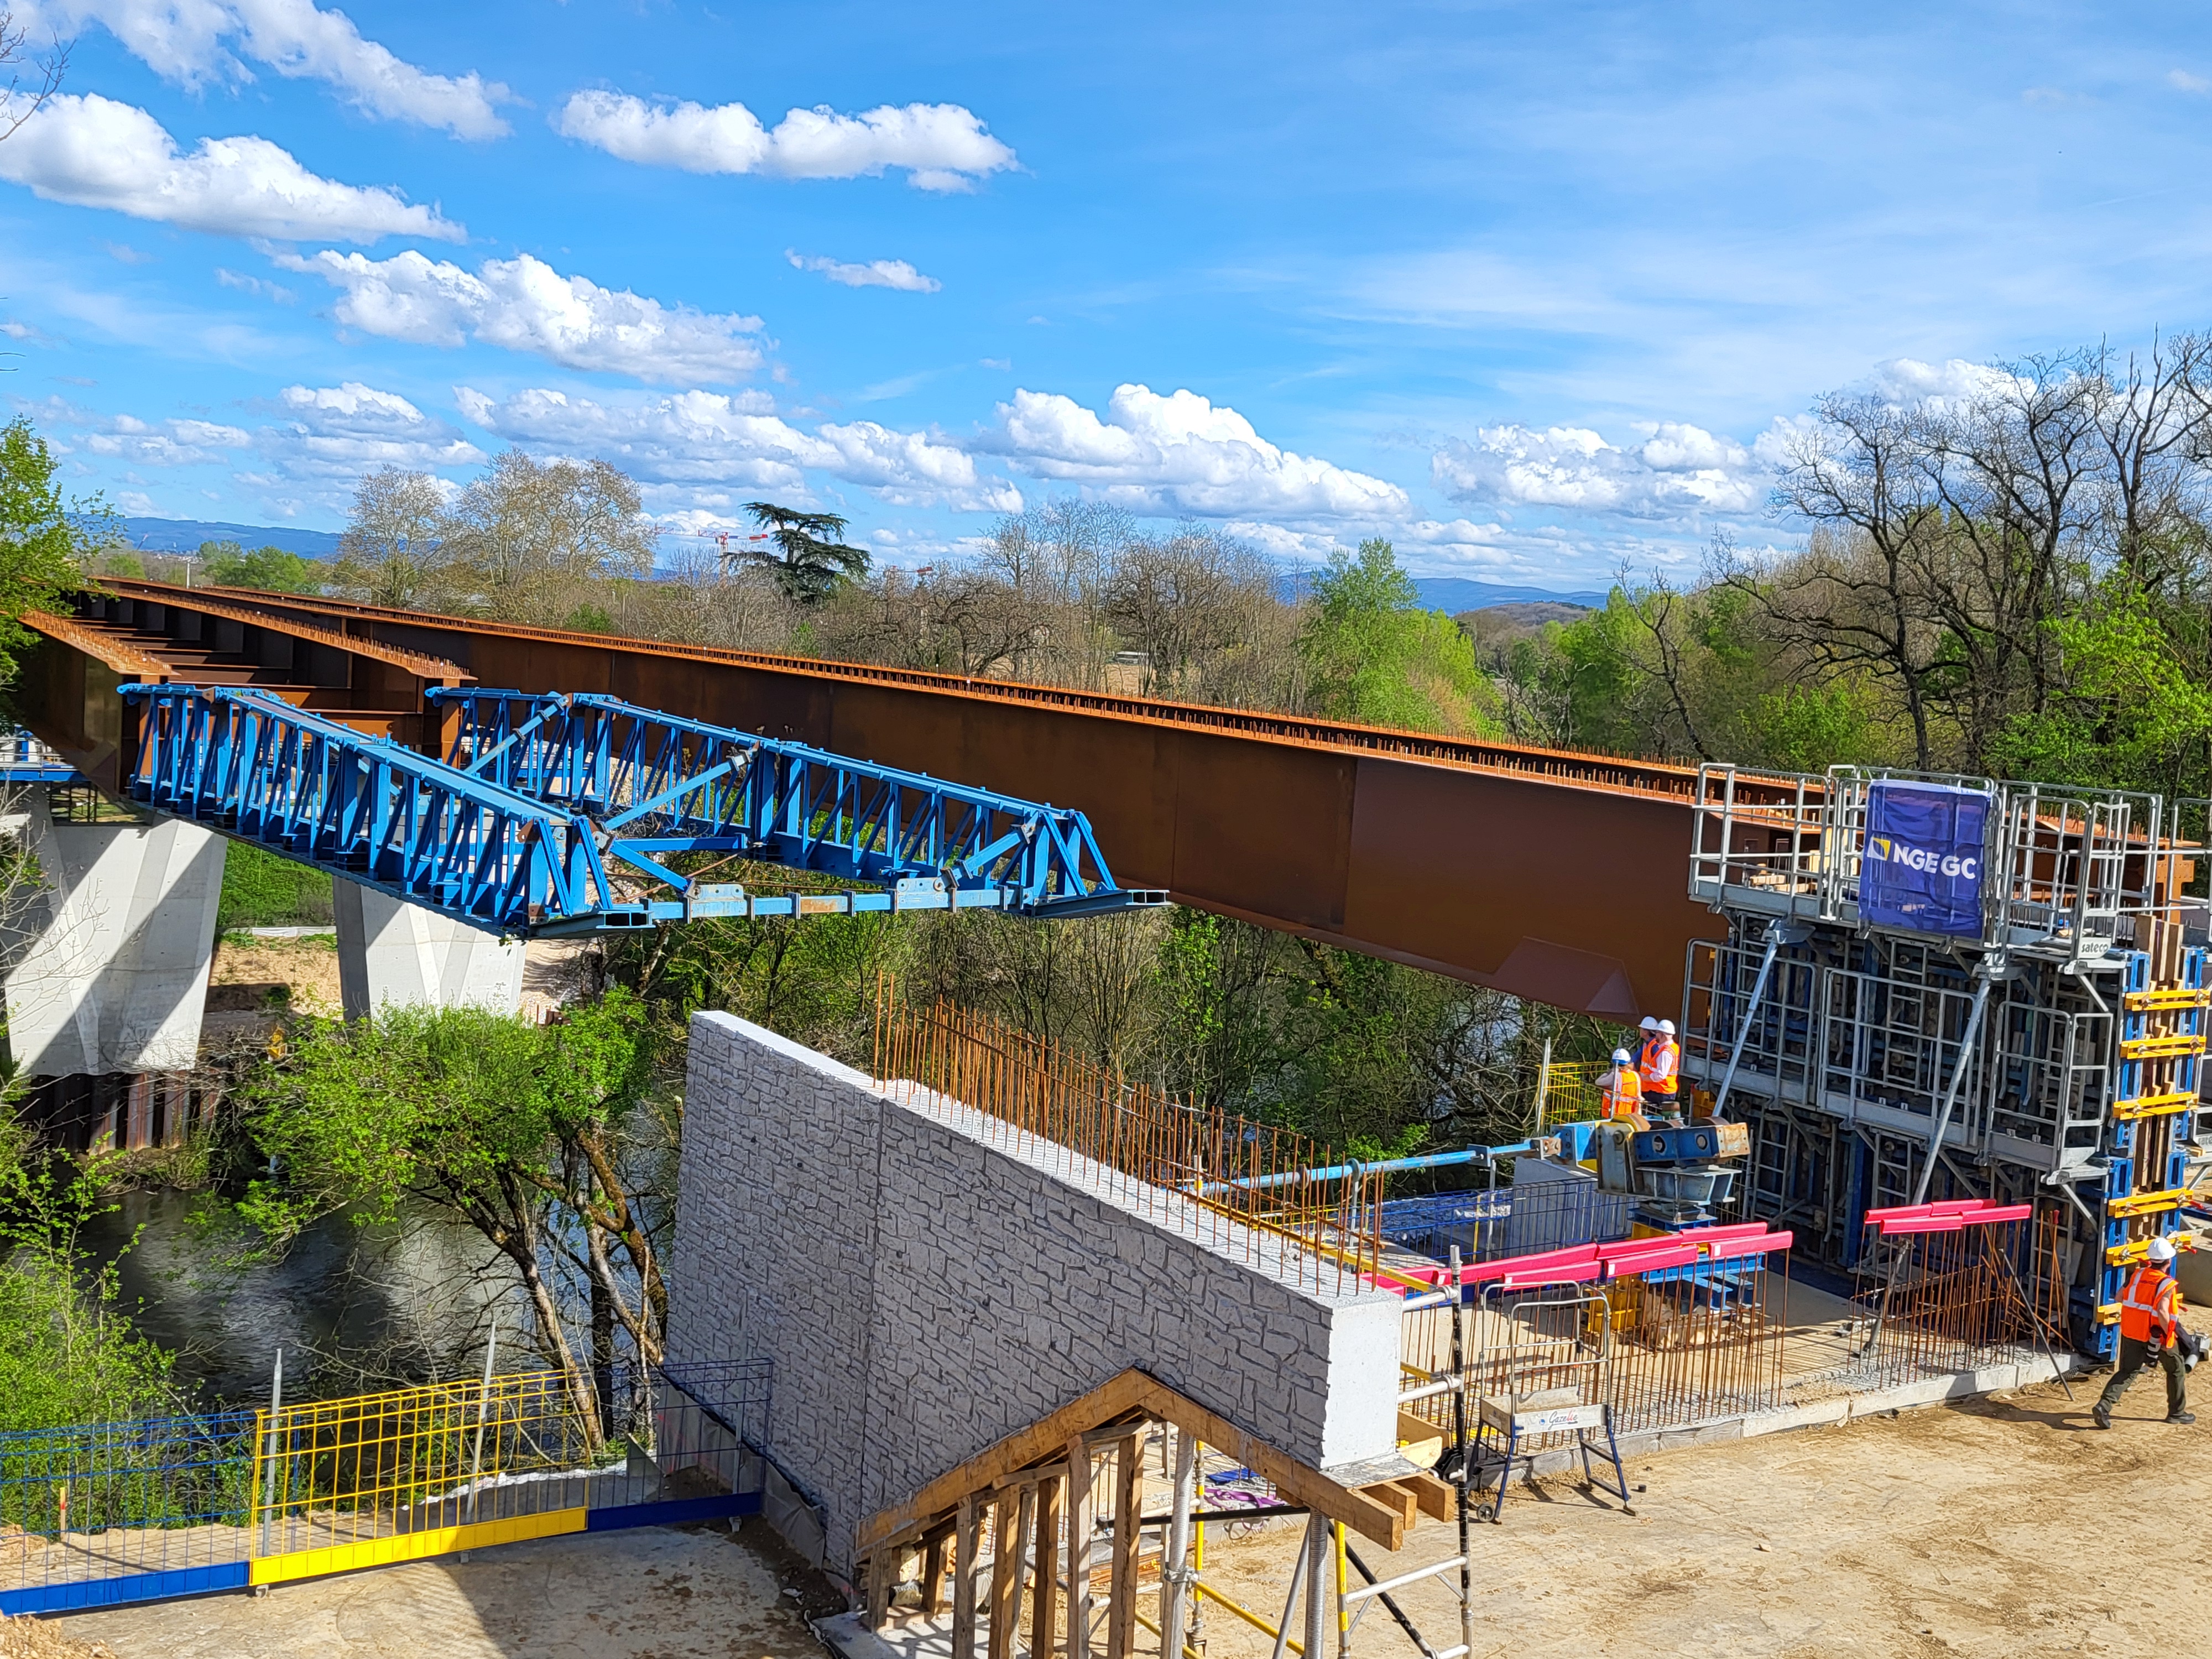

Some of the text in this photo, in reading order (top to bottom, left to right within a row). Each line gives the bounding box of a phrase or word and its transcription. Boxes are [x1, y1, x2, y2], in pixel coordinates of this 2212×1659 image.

[1893, 843, 1976, 879] NGE GC
[2081, 942, 2109, 953] sateco
